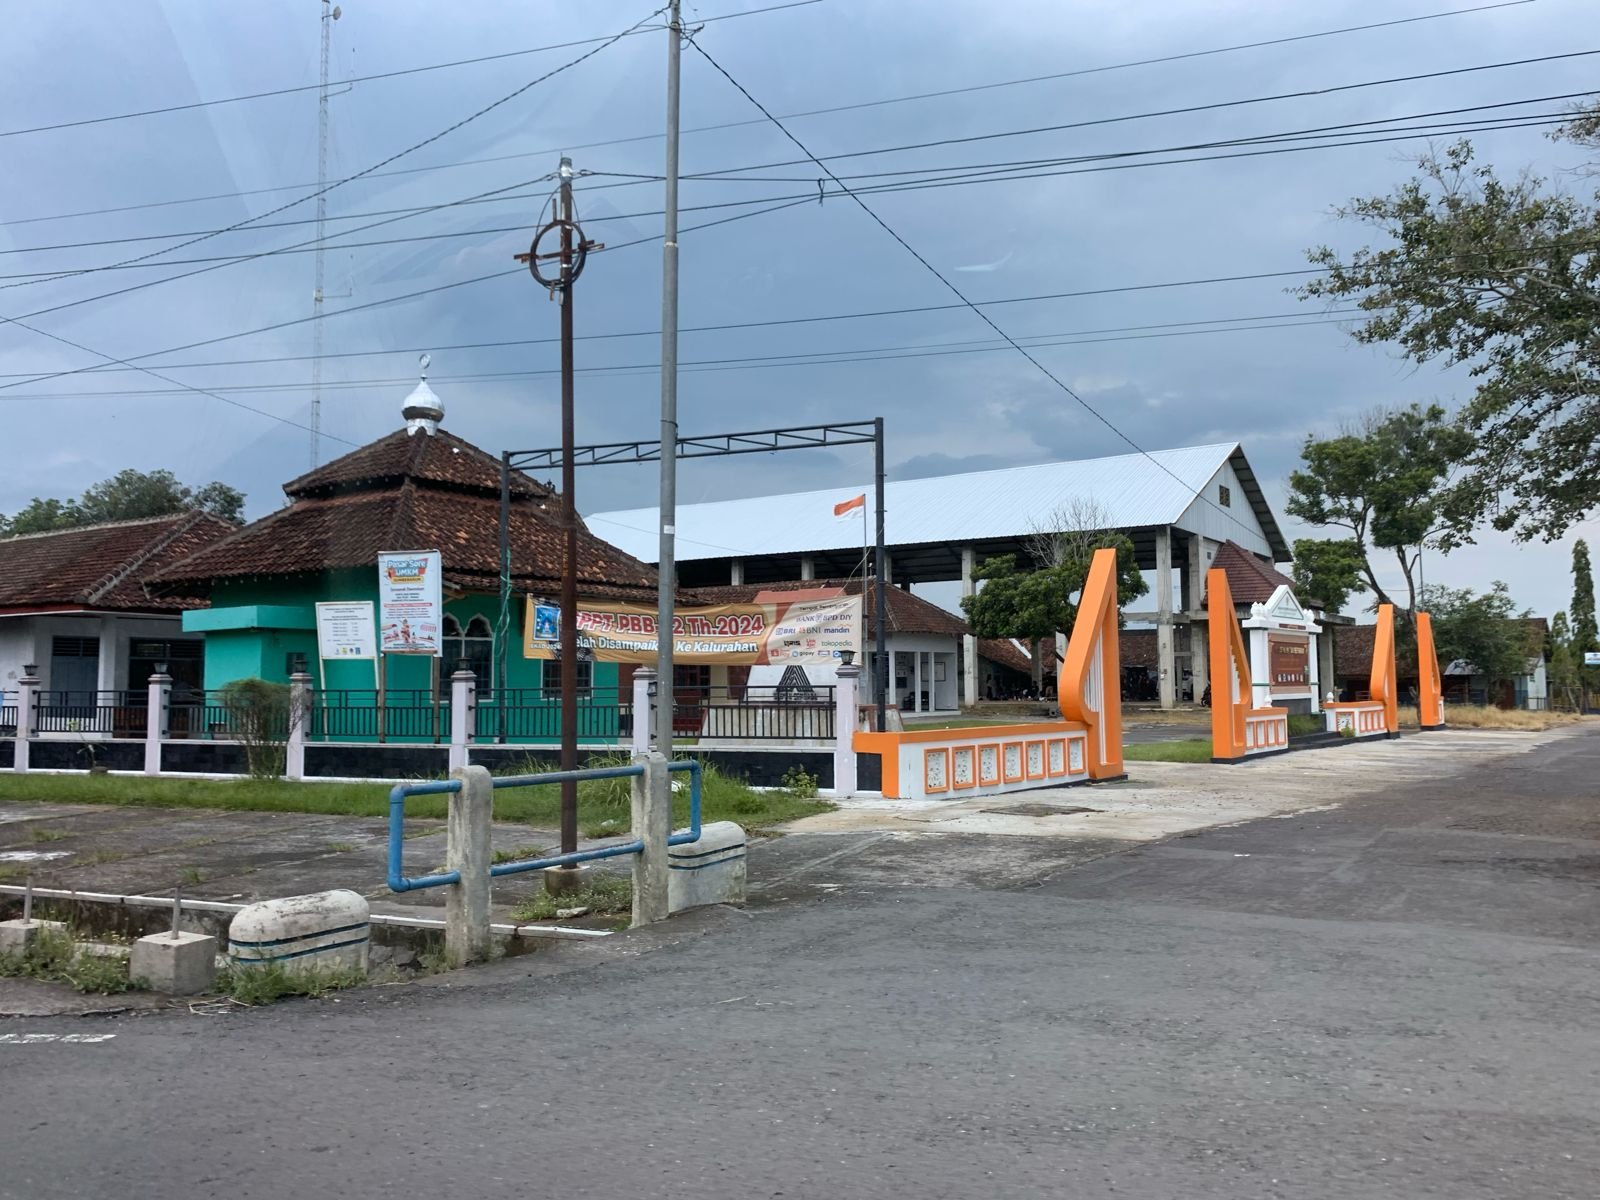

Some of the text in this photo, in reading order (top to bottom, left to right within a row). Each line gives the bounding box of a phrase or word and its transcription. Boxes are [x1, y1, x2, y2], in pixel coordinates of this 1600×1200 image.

[577, 611, 614, 633] PPT
[617, 613, 684, 635] PBB-2
[576, 636, 597, 649] elah
[676, 640, 692, 652] Ke
[693, 641, 758, 653] Kalurahan
